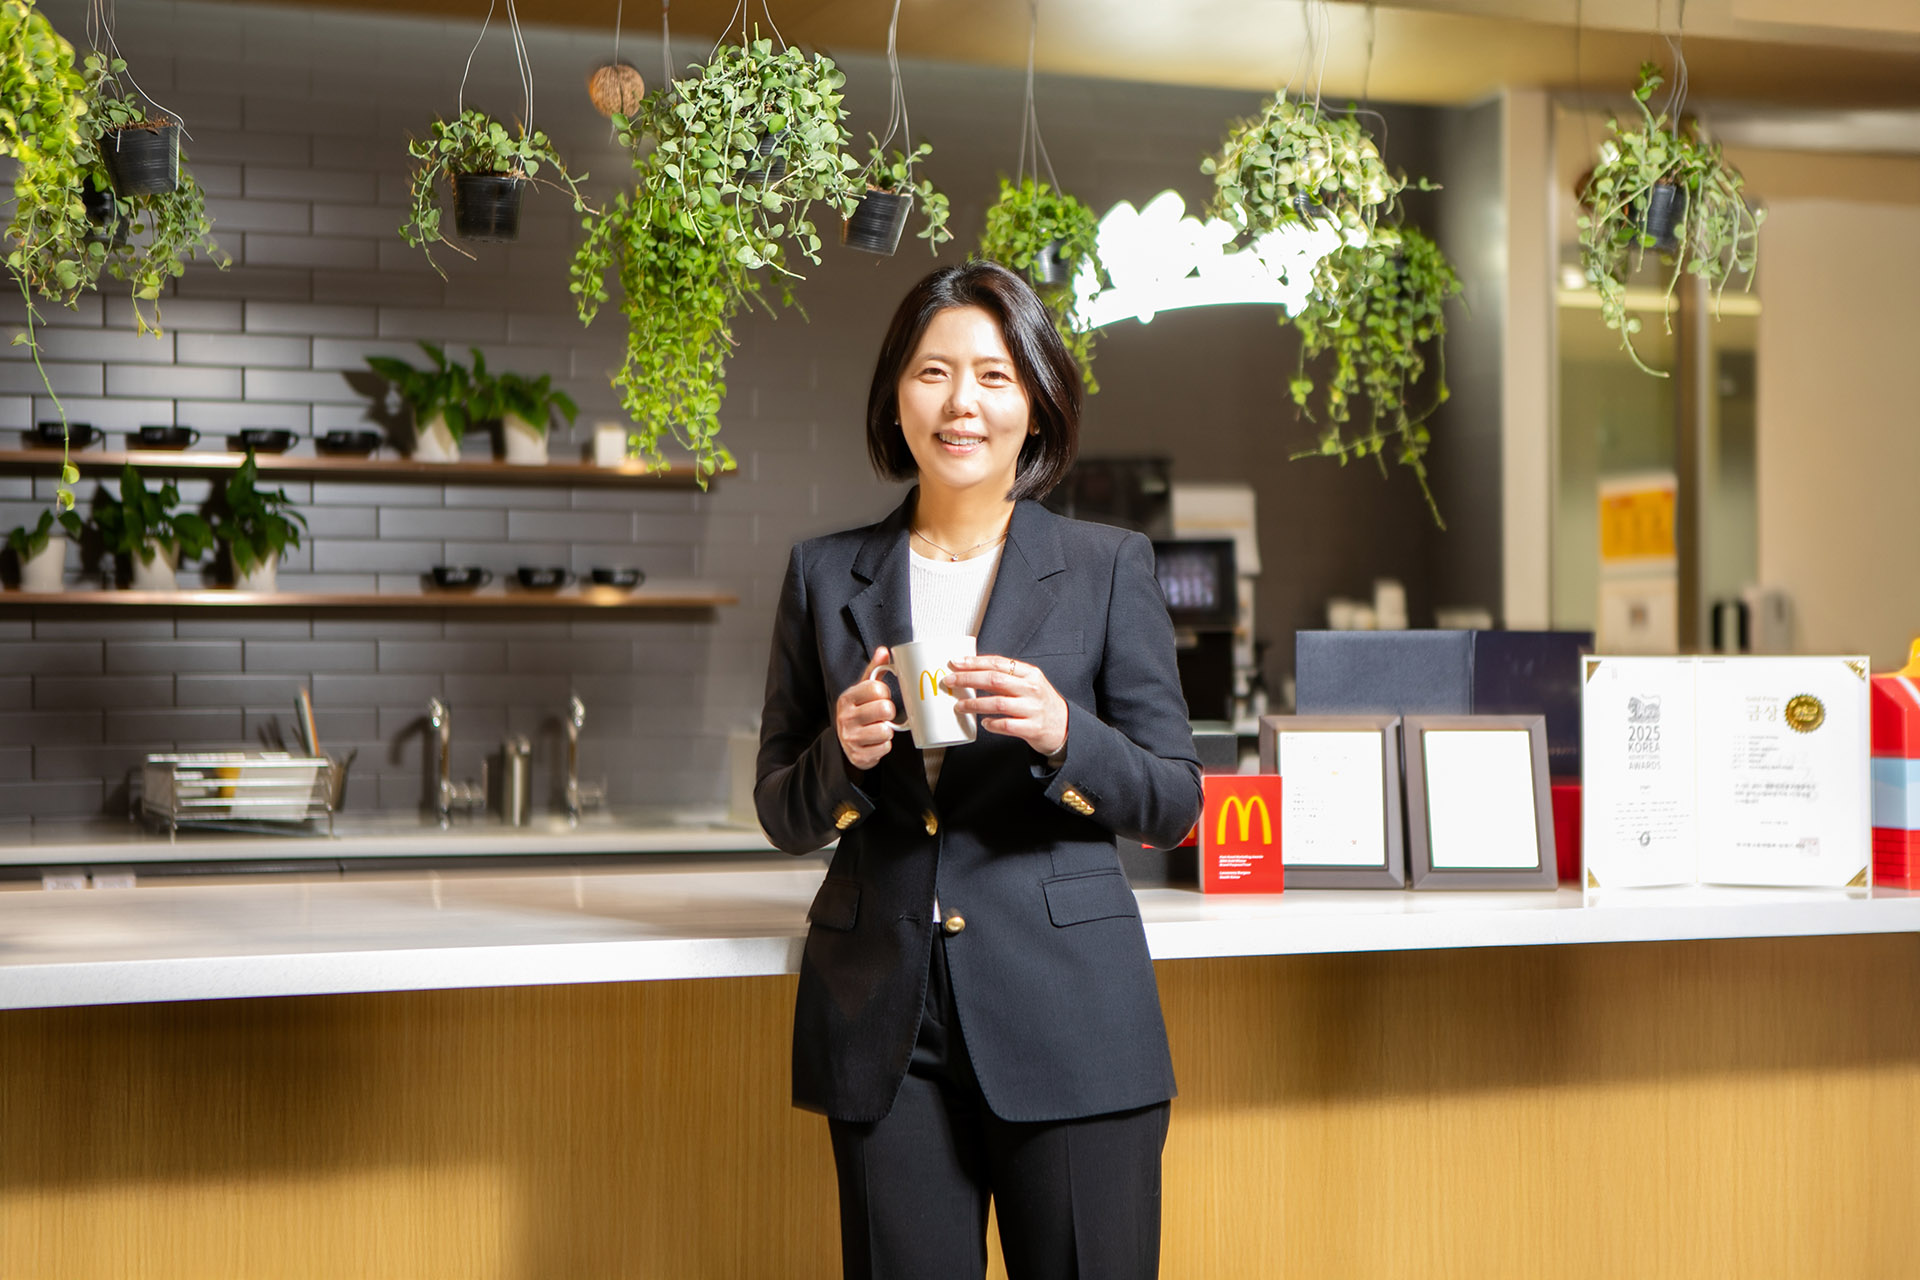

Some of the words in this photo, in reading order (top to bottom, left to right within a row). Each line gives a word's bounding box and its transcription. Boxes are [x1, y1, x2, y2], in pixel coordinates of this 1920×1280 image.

[1747, 704, 1778, 722] 금상
[1628, 725, 1661, 742] 2025
[1628, 742, 1661, 753] KOREA
[1628, 761, 1661, 771] AWARDS
